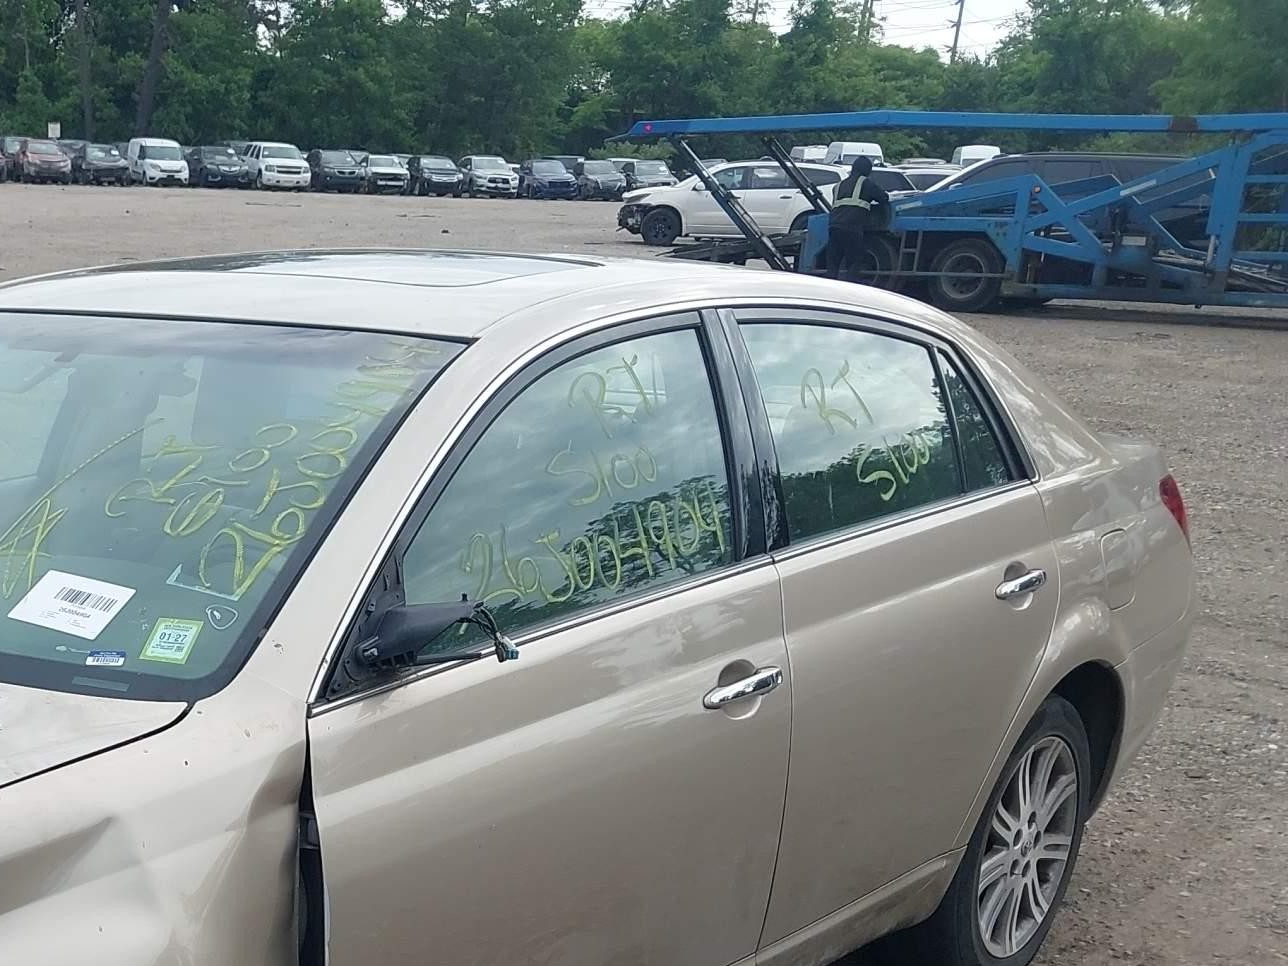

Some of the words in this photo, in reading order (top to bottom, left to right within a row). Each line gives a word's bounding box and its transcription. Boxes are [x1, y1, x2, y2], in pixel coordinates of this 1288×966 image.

[568, 354, 654, 439] RT
[800, 359, 875, 435] RT
[545, 440, 658, 507] S100
